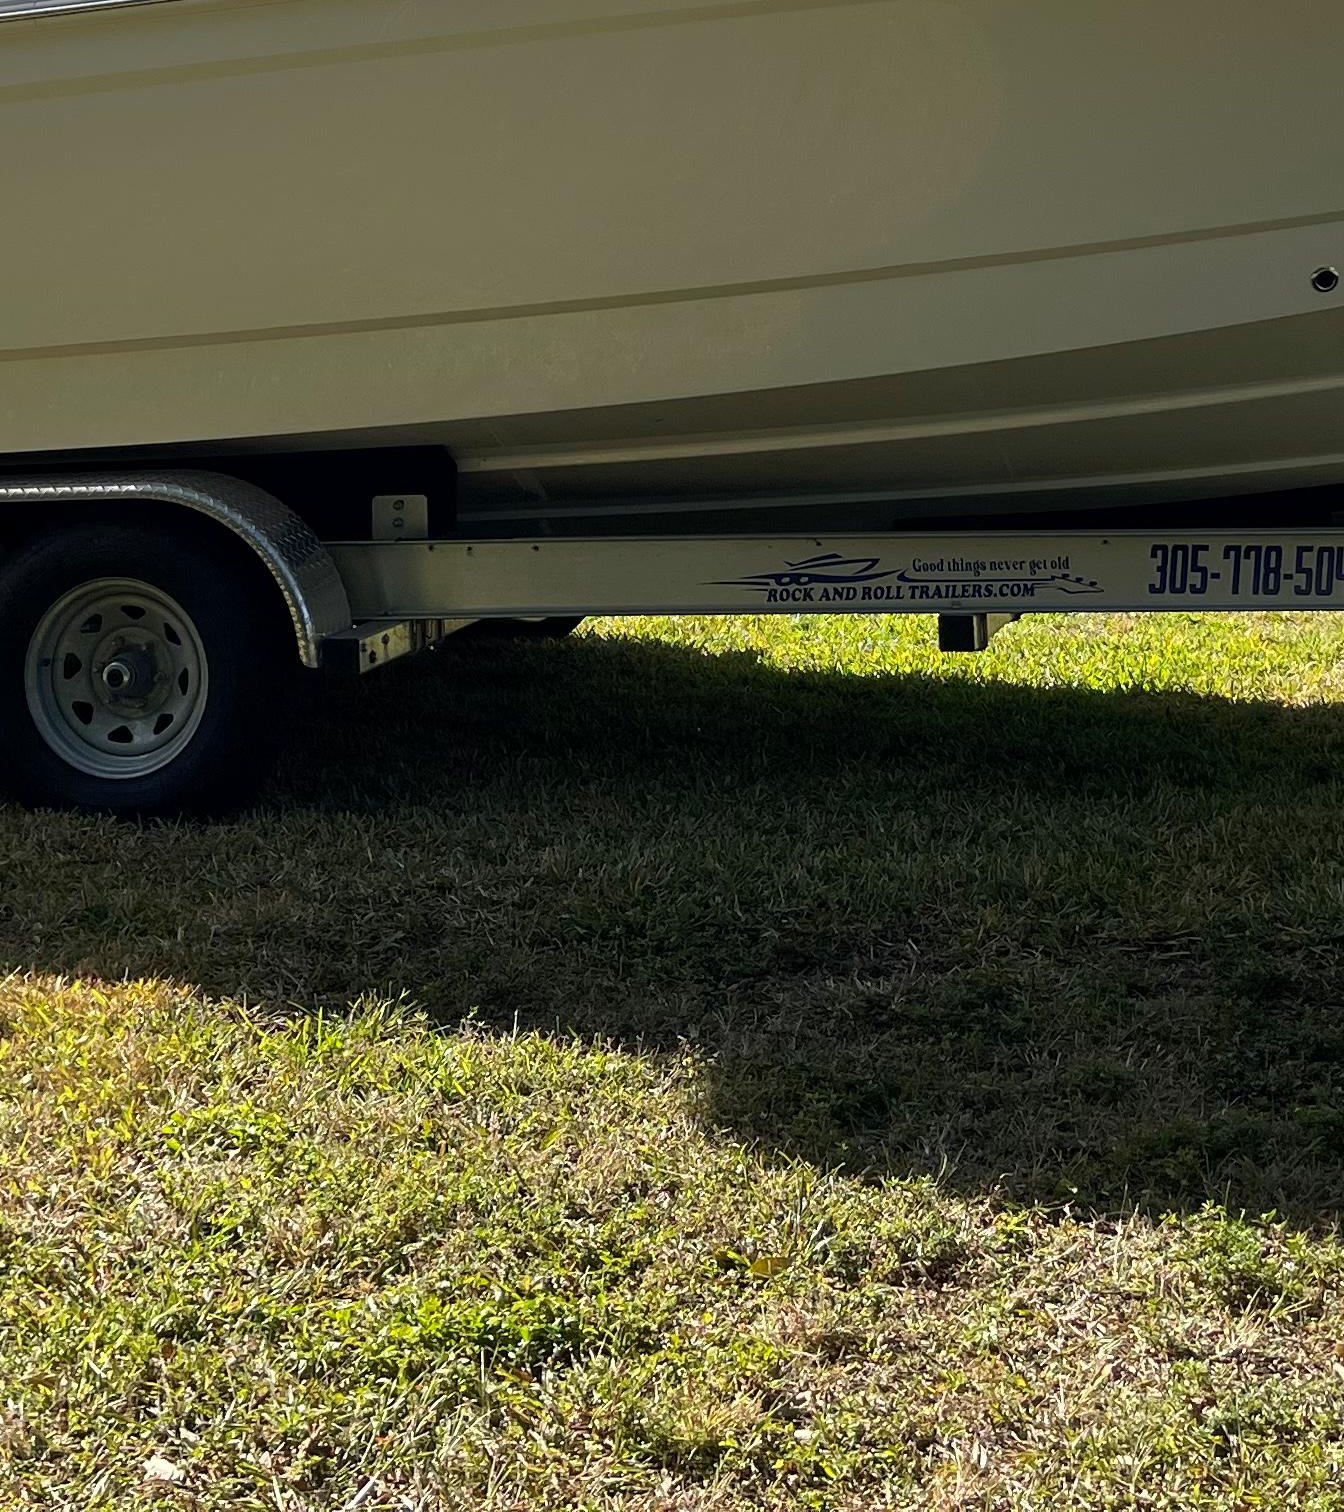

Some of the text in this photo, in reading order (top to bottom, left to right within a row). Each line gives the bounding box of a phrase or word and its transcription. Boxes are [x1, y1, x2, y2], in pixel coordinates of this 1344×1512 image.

[912, 556, 1070, 576] Good things never get old
[767, 583, 1036, 602] ROCK AND ROLL TRAILERS.COM
